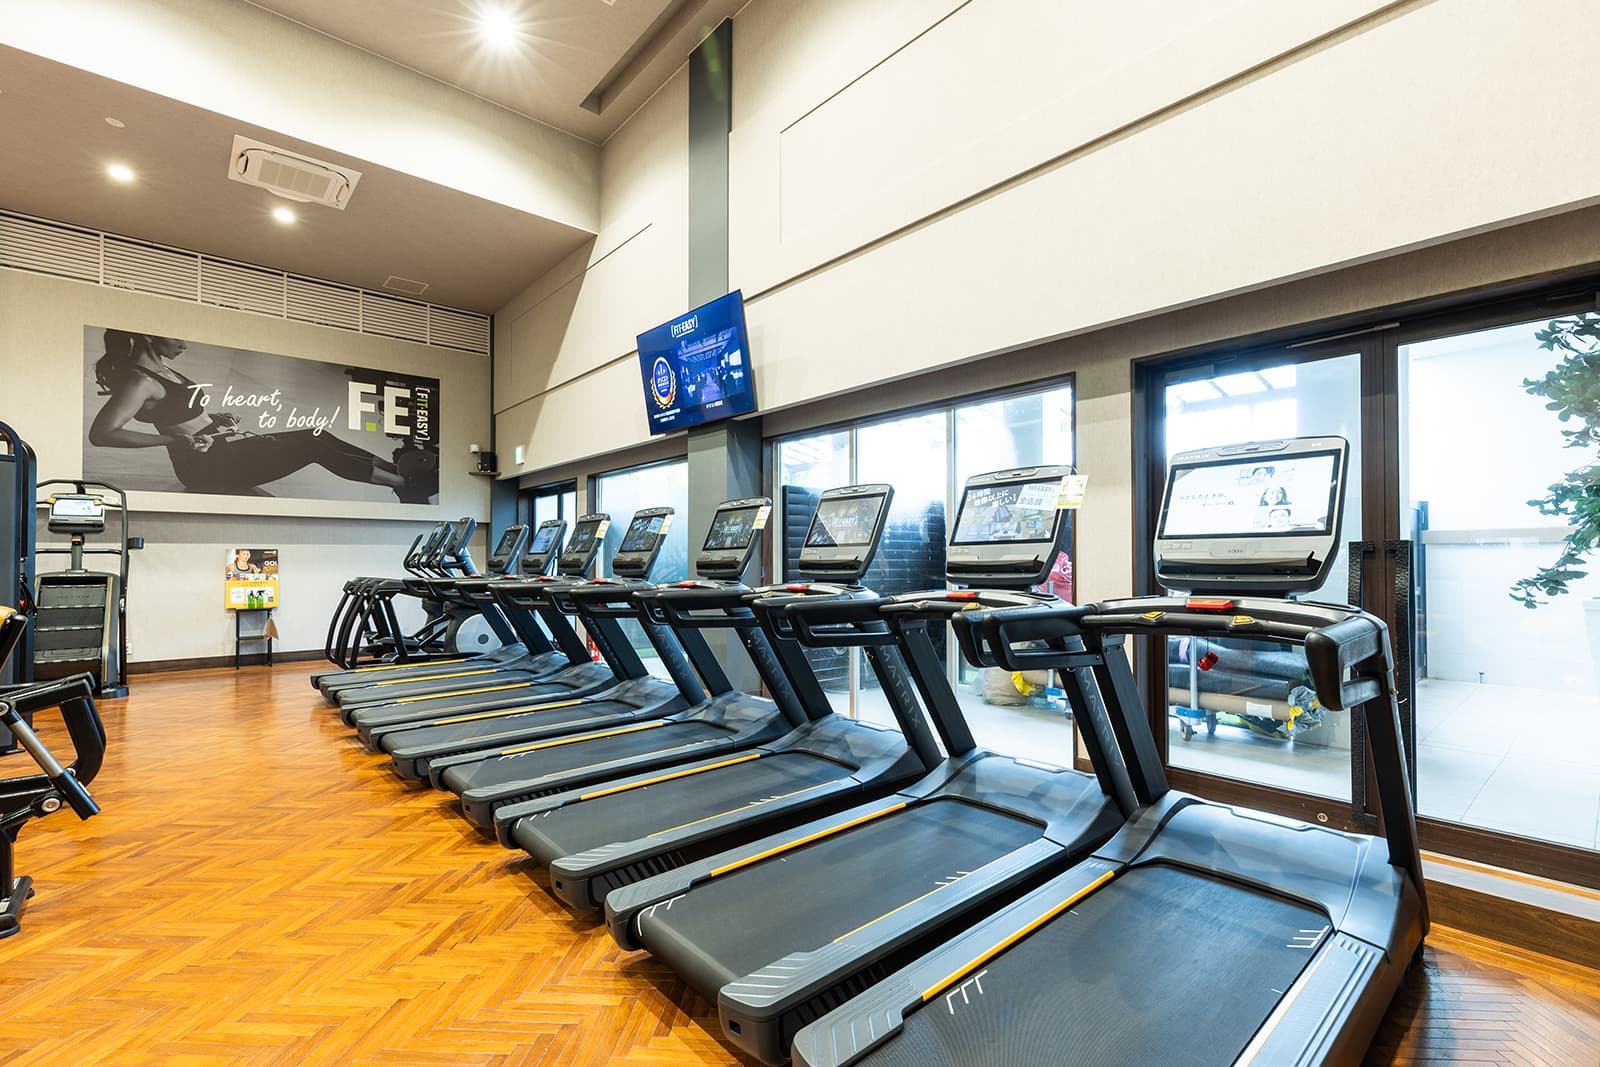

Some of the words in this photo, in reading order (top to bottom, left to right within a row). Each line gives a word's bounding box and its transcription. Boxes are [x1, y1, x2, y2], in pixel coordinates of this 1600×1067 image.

[187, 383, 213, 409] To
[221, 385, 283, 411] heart,
[258, 410, 276, 428] to
[286, 406, 341, 437] body!
[750, 629, 790, 699] MATRIX
[880, 645, 920, 728] MATRIX
[1080, 667, 1122, 768] MATRIX
